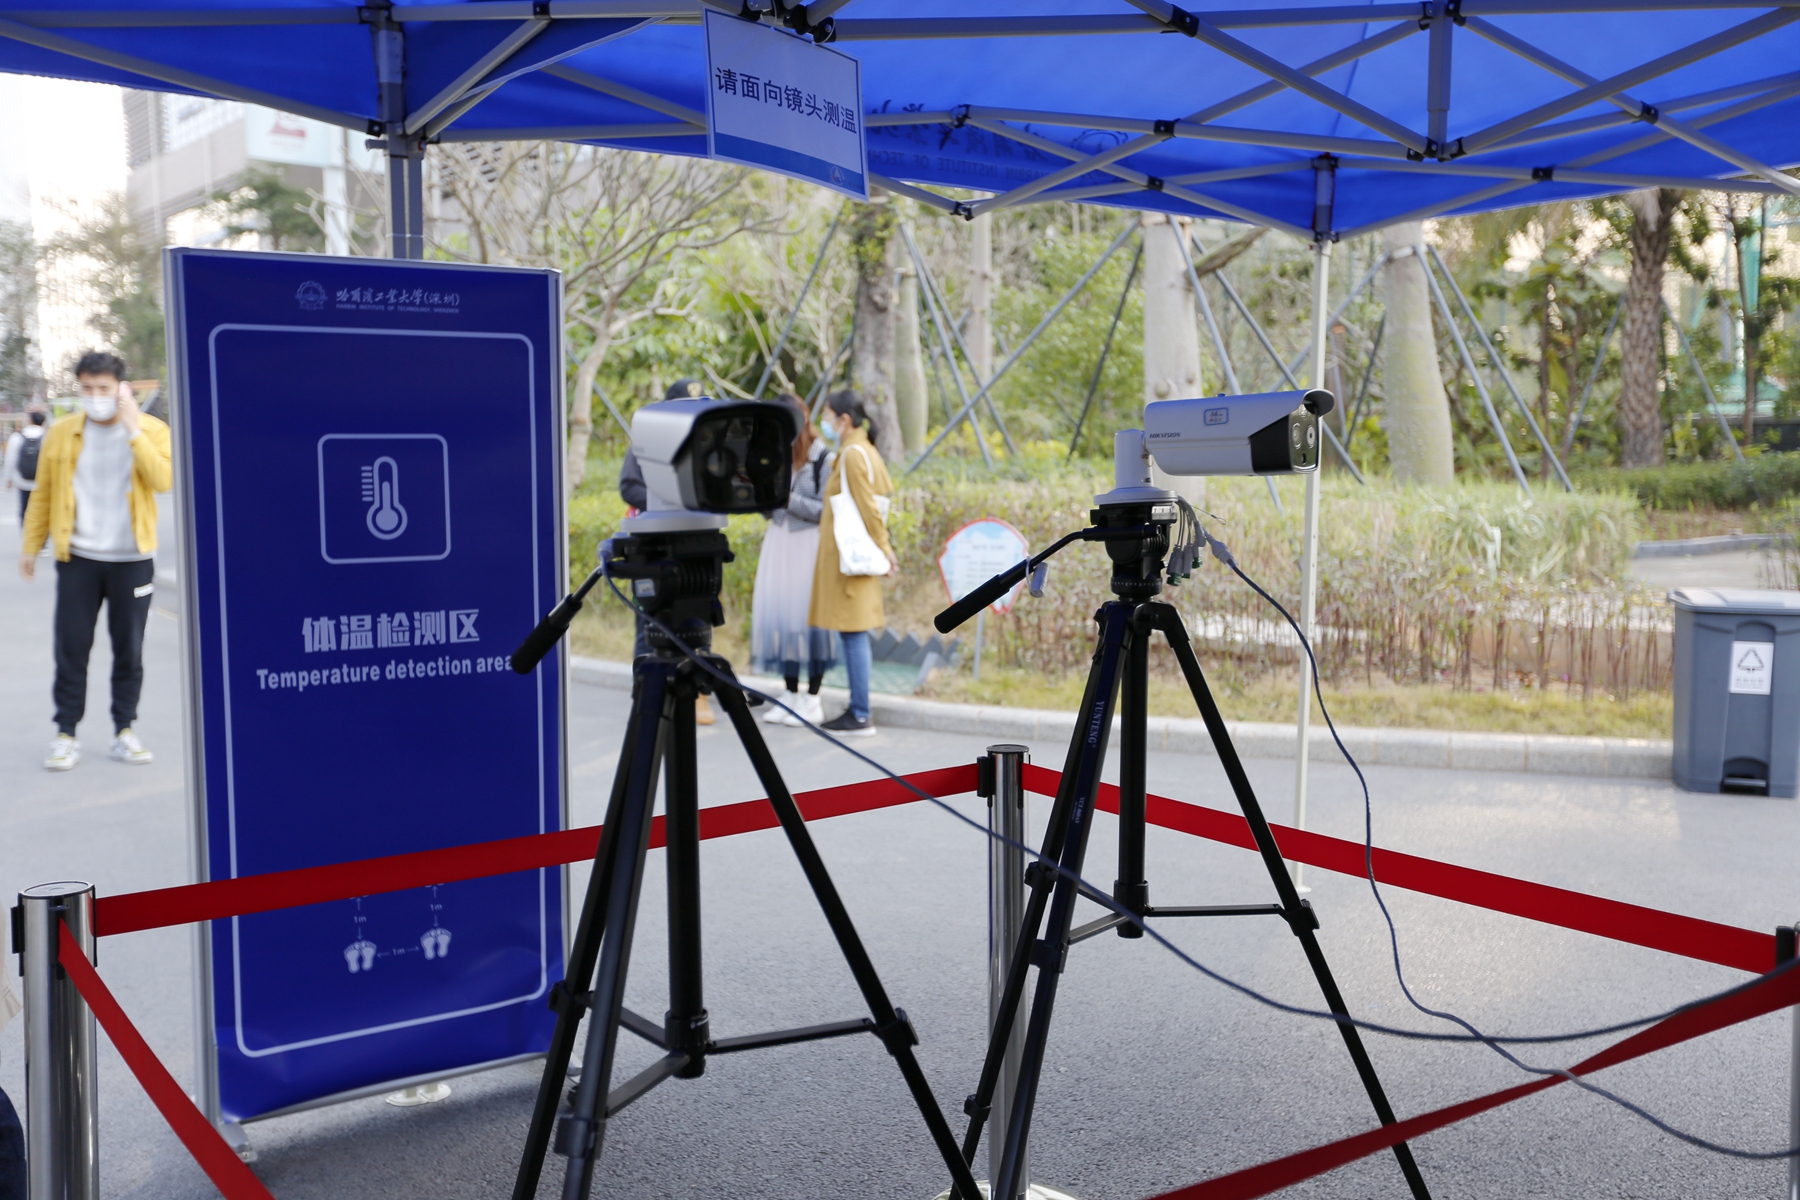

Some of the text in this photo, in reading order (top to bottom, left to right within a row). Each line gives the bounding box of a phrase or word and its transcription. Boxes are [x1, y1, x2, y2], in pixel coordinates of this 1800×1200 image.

[715, 67, 857, 134] 请面向镜头测温
[302, 609, 480, 653] 体温检测区
[256, 655, 512, 692] Temperature detection area
[1088, 701, 1105, 744] YUNTENG
[353, 915, 367, 924] 1m
[430, 903, 443, 912] 1m
[392, 947, 406, 956] 1m
